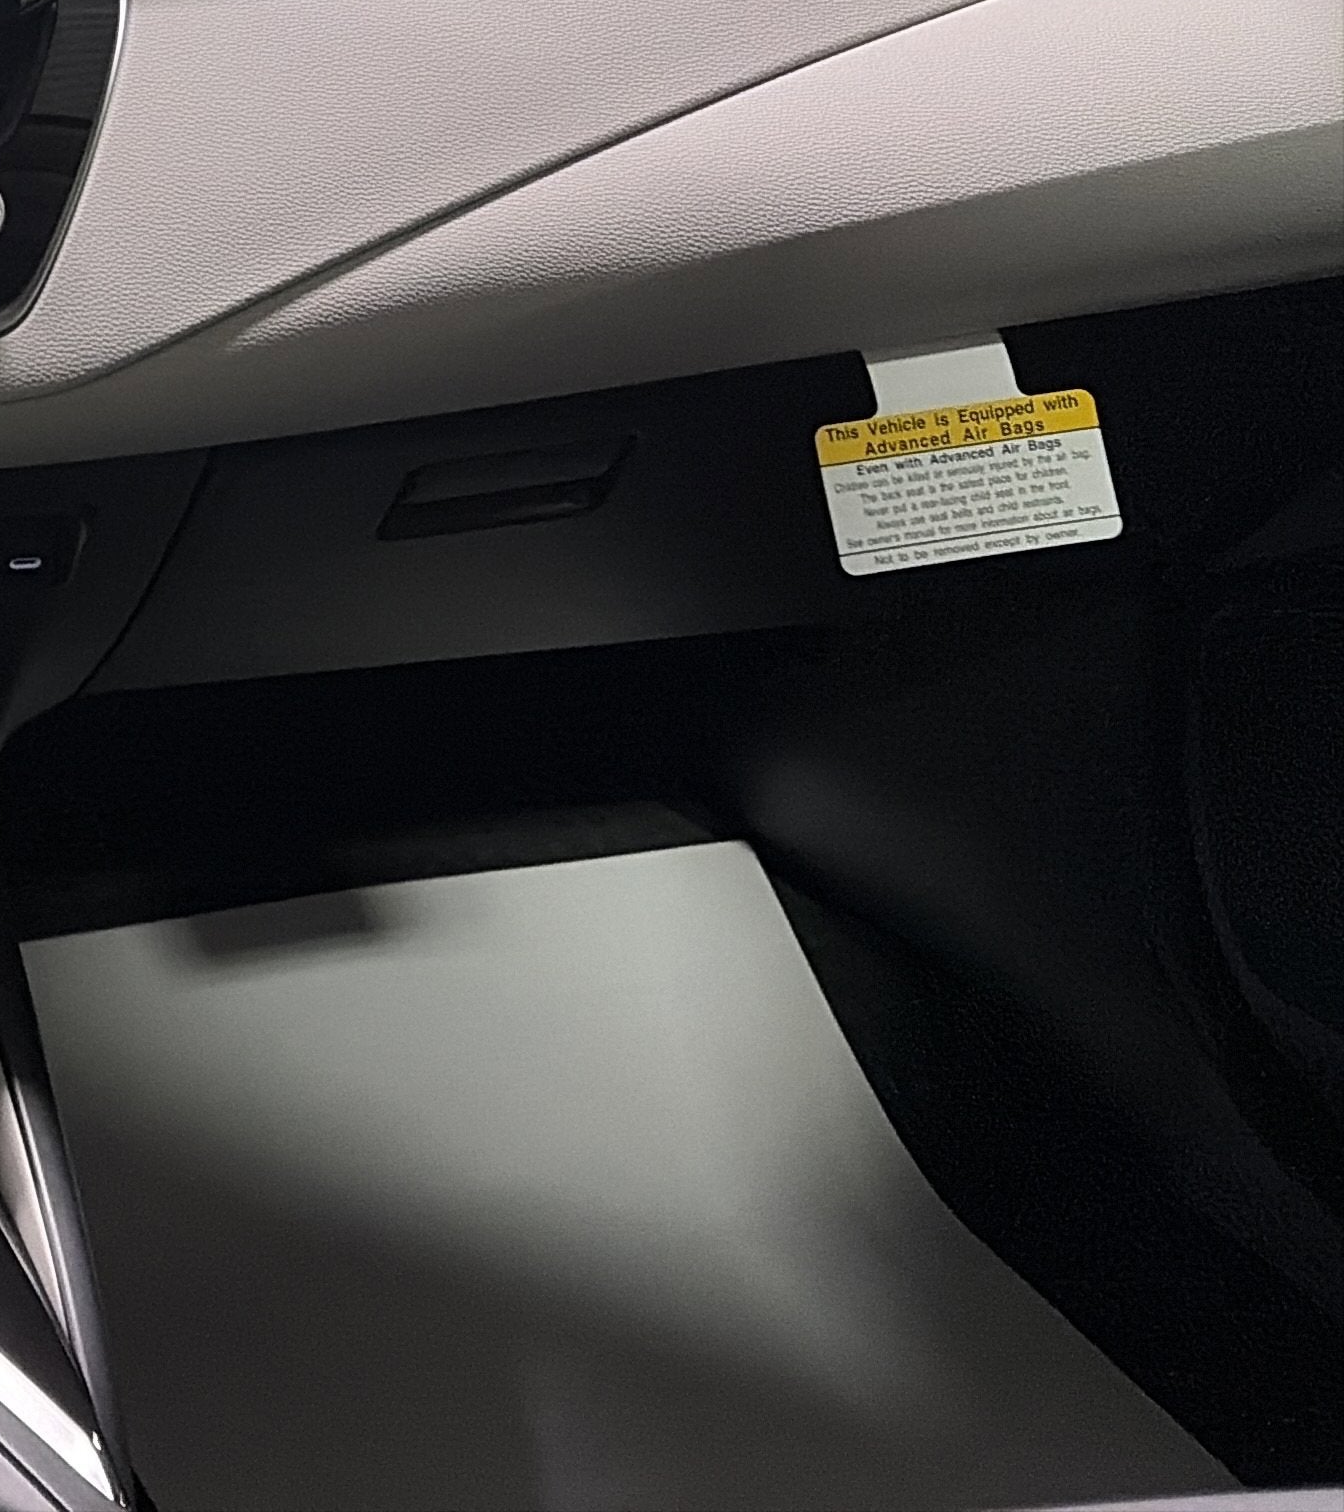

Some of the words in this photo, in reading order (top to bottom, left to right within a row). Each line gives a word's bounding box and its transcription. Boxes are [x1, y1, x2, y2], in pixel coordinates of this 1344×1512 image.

[825, 428, 859, 442] This
[867, 417, 926, 436] Vehicle
[957, 399, 1034, 424] Equipped
[1043, 394, 1079, 411] with
[865, 430, 951, 456] Advanced
[963, 427, 988, 442] Air
[1000, 419, 1045, 436] Bags
[856, 462, 888, 476] Even
[895, 457, 923, 470] with
[930, 447, 994, 465] Advanced
[1002, 442, 1021, 455] Air
[1028, 438, 1062, 451] Bags
[874, 554, 893, 565] Not
[914, 550, 928, 560] be
[932, 541, 980, 557] removed
